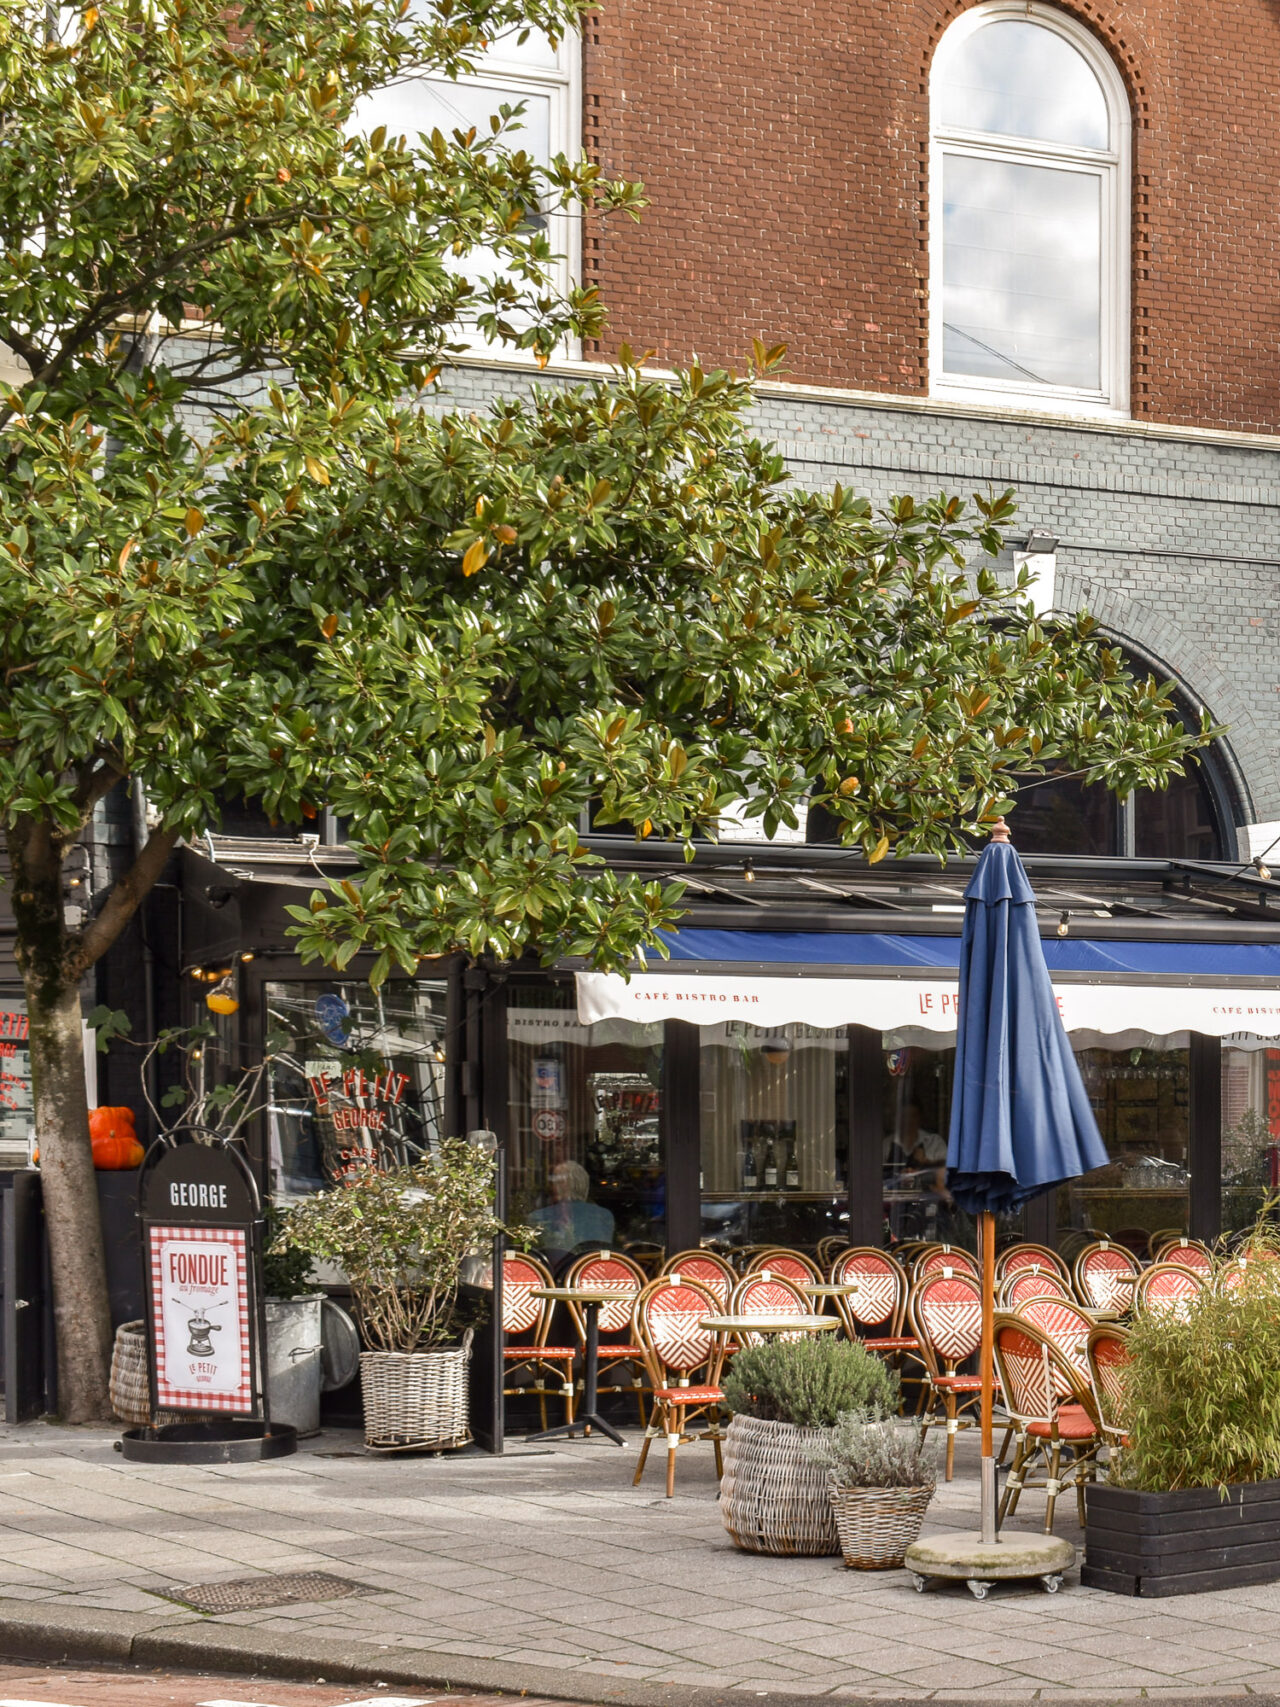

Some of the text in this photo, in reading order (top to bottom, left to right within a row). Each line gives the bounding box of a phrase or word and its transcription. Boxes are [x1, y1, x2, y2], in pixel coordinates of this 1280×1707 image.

[676, 993, 727, 1002] BISTRO
[733, 995, 760, 1003] BAR
[919, 993, 933, 1014] LE
[310, 1071, 333, 1107] LE
[333, 1108, 387, 1131] GEORGE
[170, 1182, 228, 1208] GEORGE
[169, 1253, 229, 1286] FONDUE
[188, 1283, 219, 1296] fromage
[189, 1362, 219, 1376] LE PETIT
